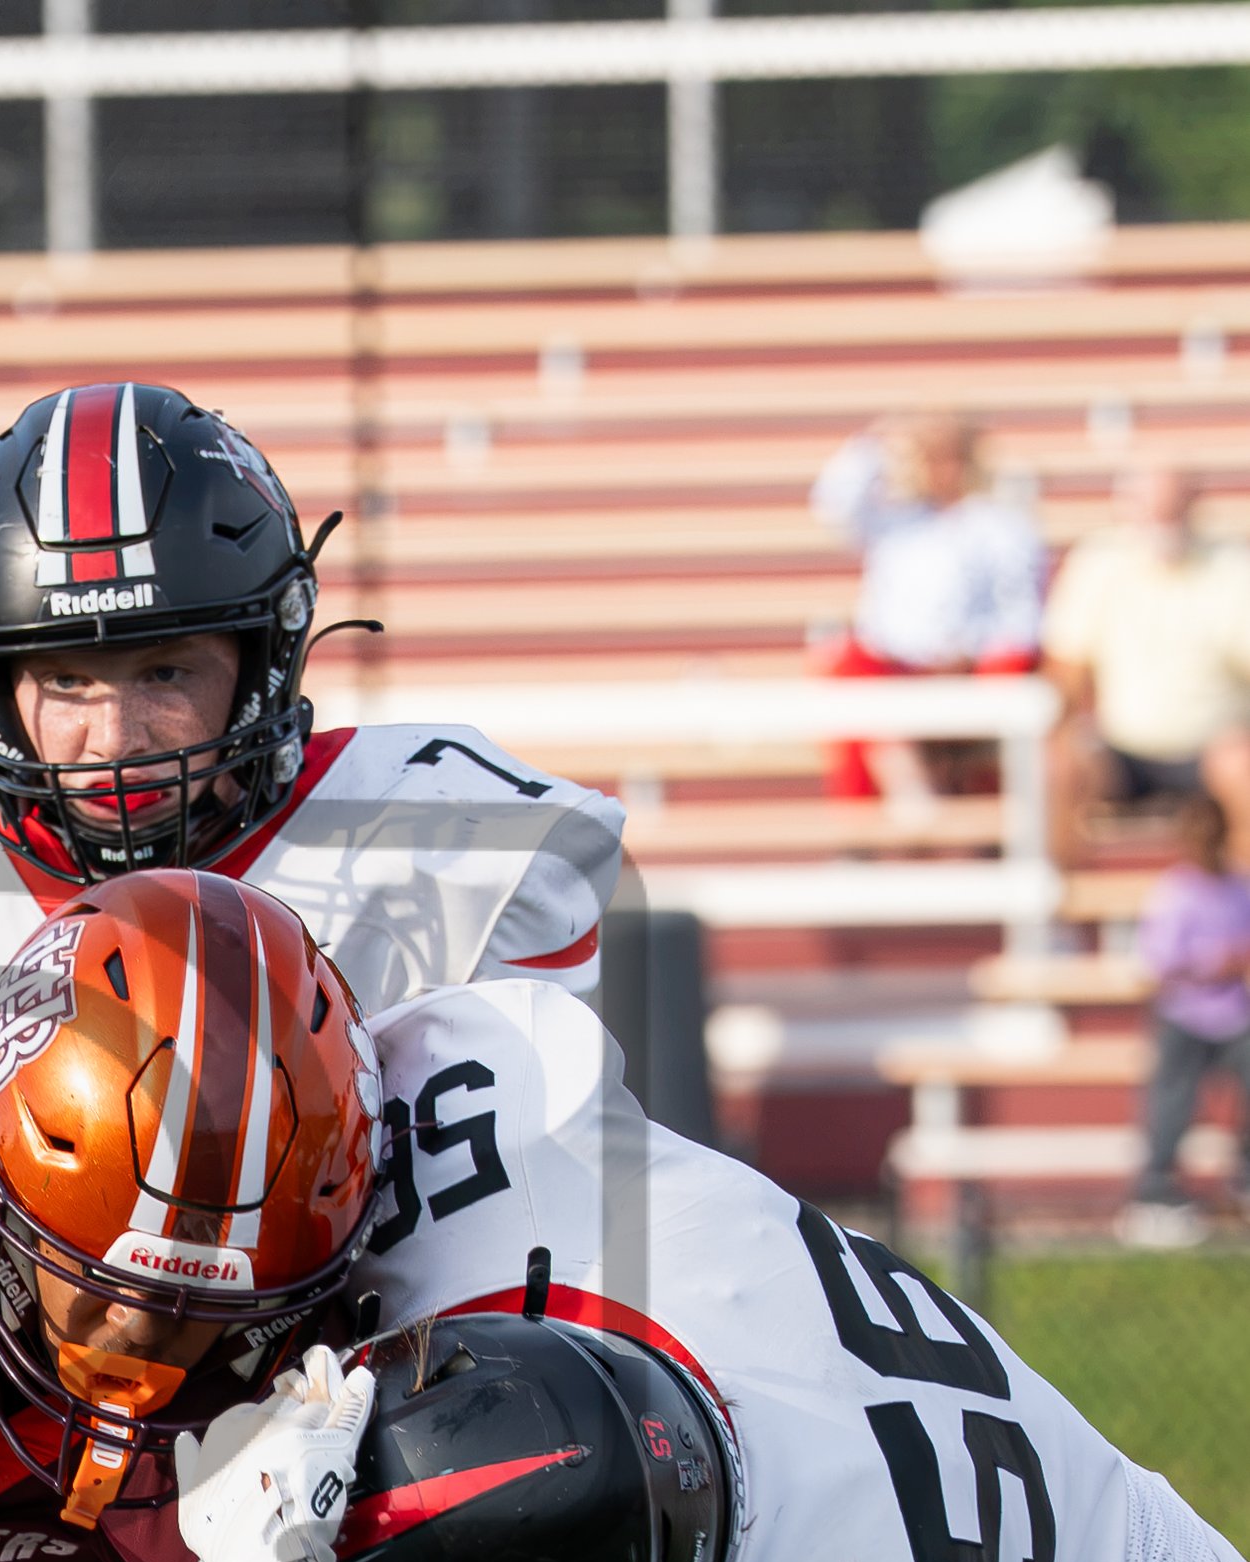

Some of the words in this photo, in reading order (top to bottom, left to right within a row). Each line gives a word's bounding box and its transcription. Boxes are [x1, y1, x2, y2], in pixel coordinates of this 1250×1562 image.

[49, 582, 154, 617] Riddell
[101, 844, 154, 863] Ridell
[129, 1246, 239, 1281] Riddell
